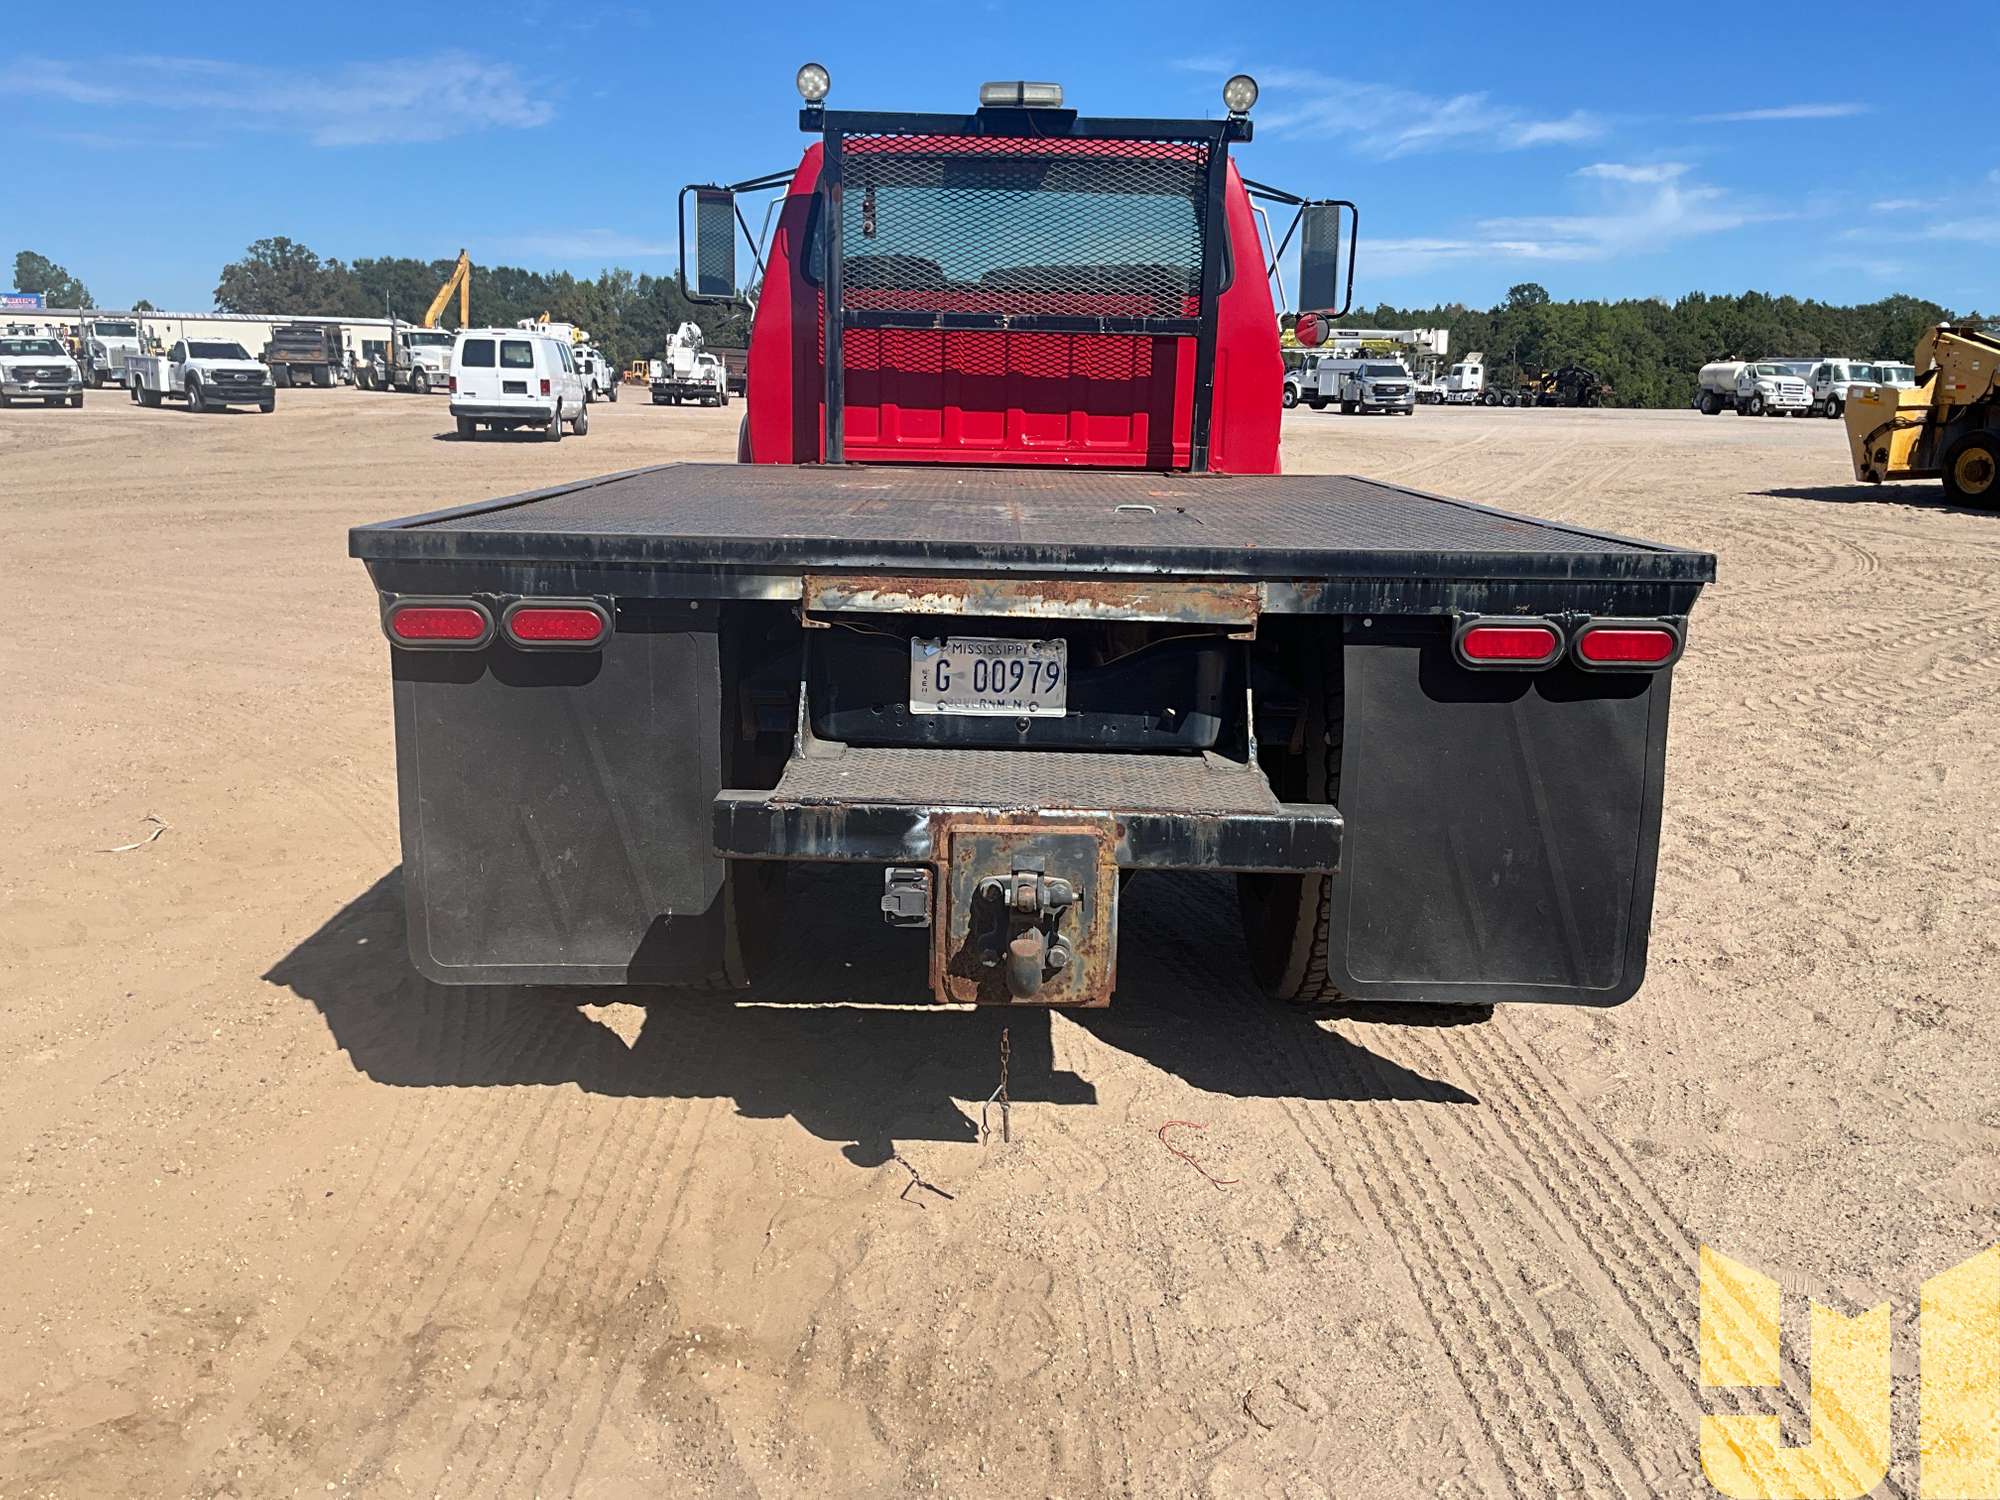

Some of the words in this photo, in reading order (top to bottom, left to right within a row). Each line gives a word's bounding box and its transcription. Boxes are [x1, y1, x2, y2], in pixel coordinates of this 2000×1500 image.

[952, 643, 1028, 656] MISSISSIPPI
[936, 658, 950, 693] G
[973, 658, 1060, 694] 00979
